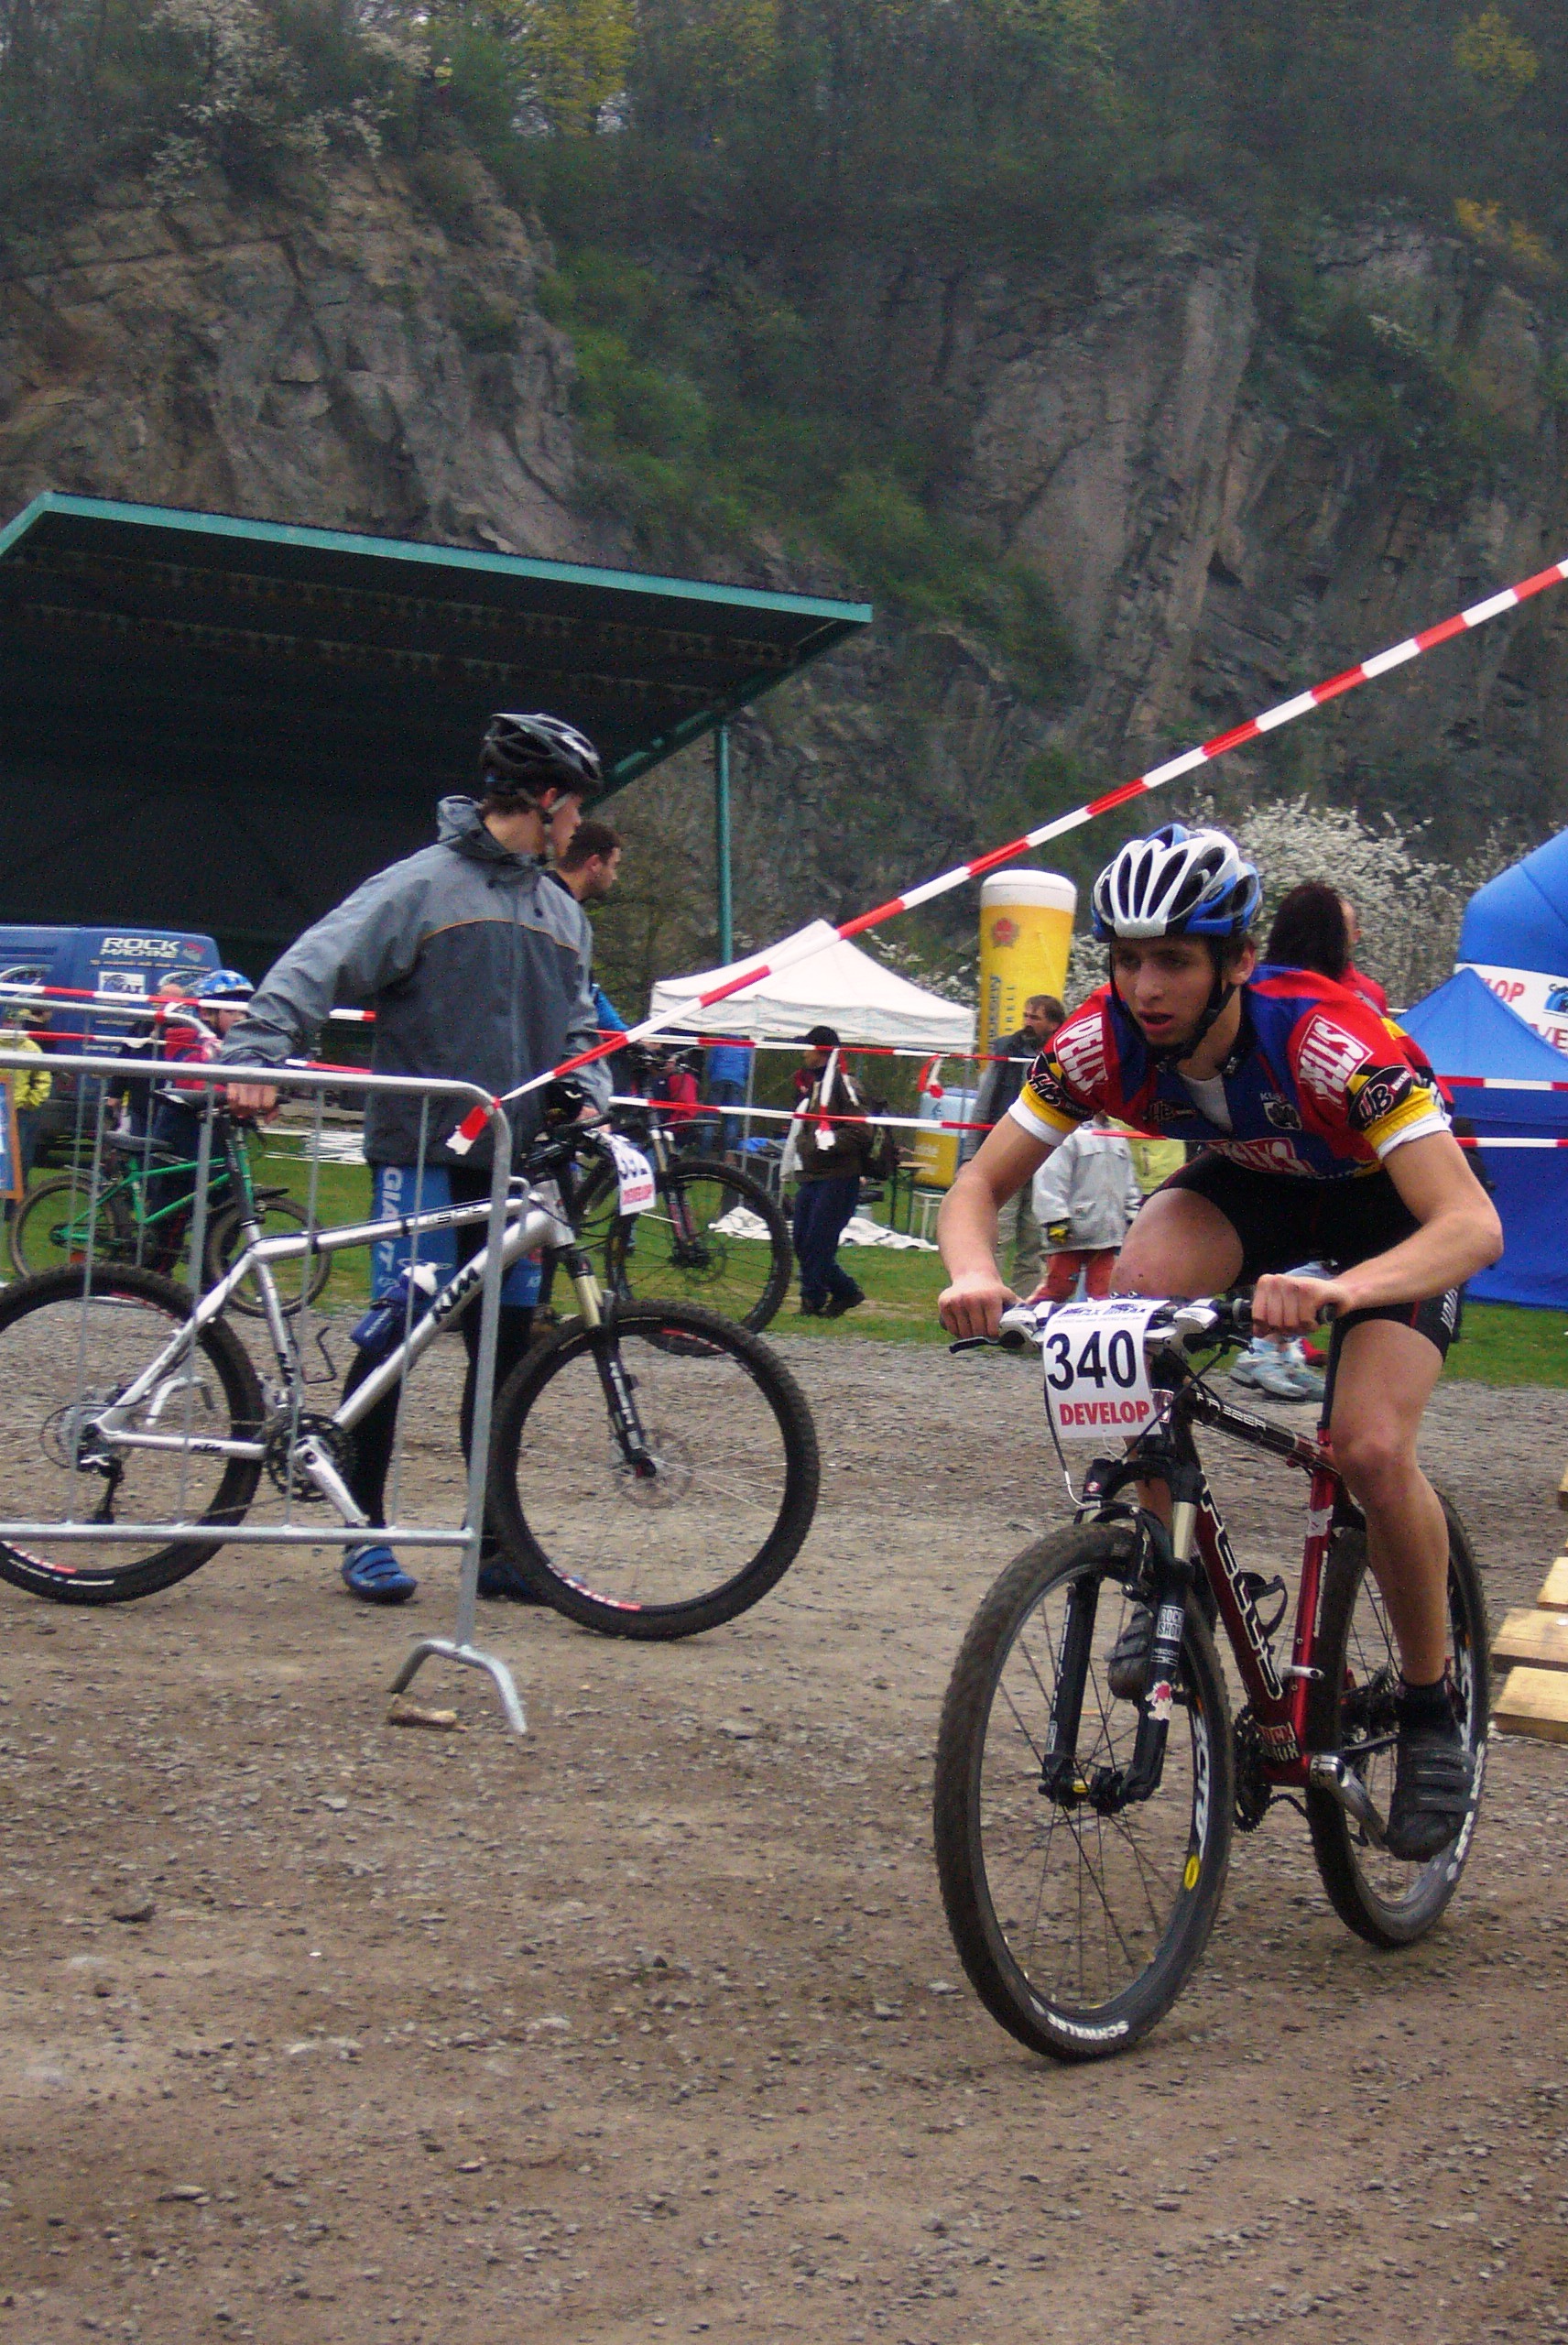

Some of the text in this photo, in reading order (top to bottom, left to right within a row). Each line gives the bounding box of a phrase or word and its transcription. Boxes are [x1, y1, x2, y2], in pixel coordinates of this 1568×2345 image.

[100, 948, 179, 959] MACHINE
[102, 937, 181, 953] ROCK
[434, 1267, 481, 1325] KTM
[1046, 1329, 1138, 1391] 340
[1059, 1400, 1150, 1426] DEVELOP
